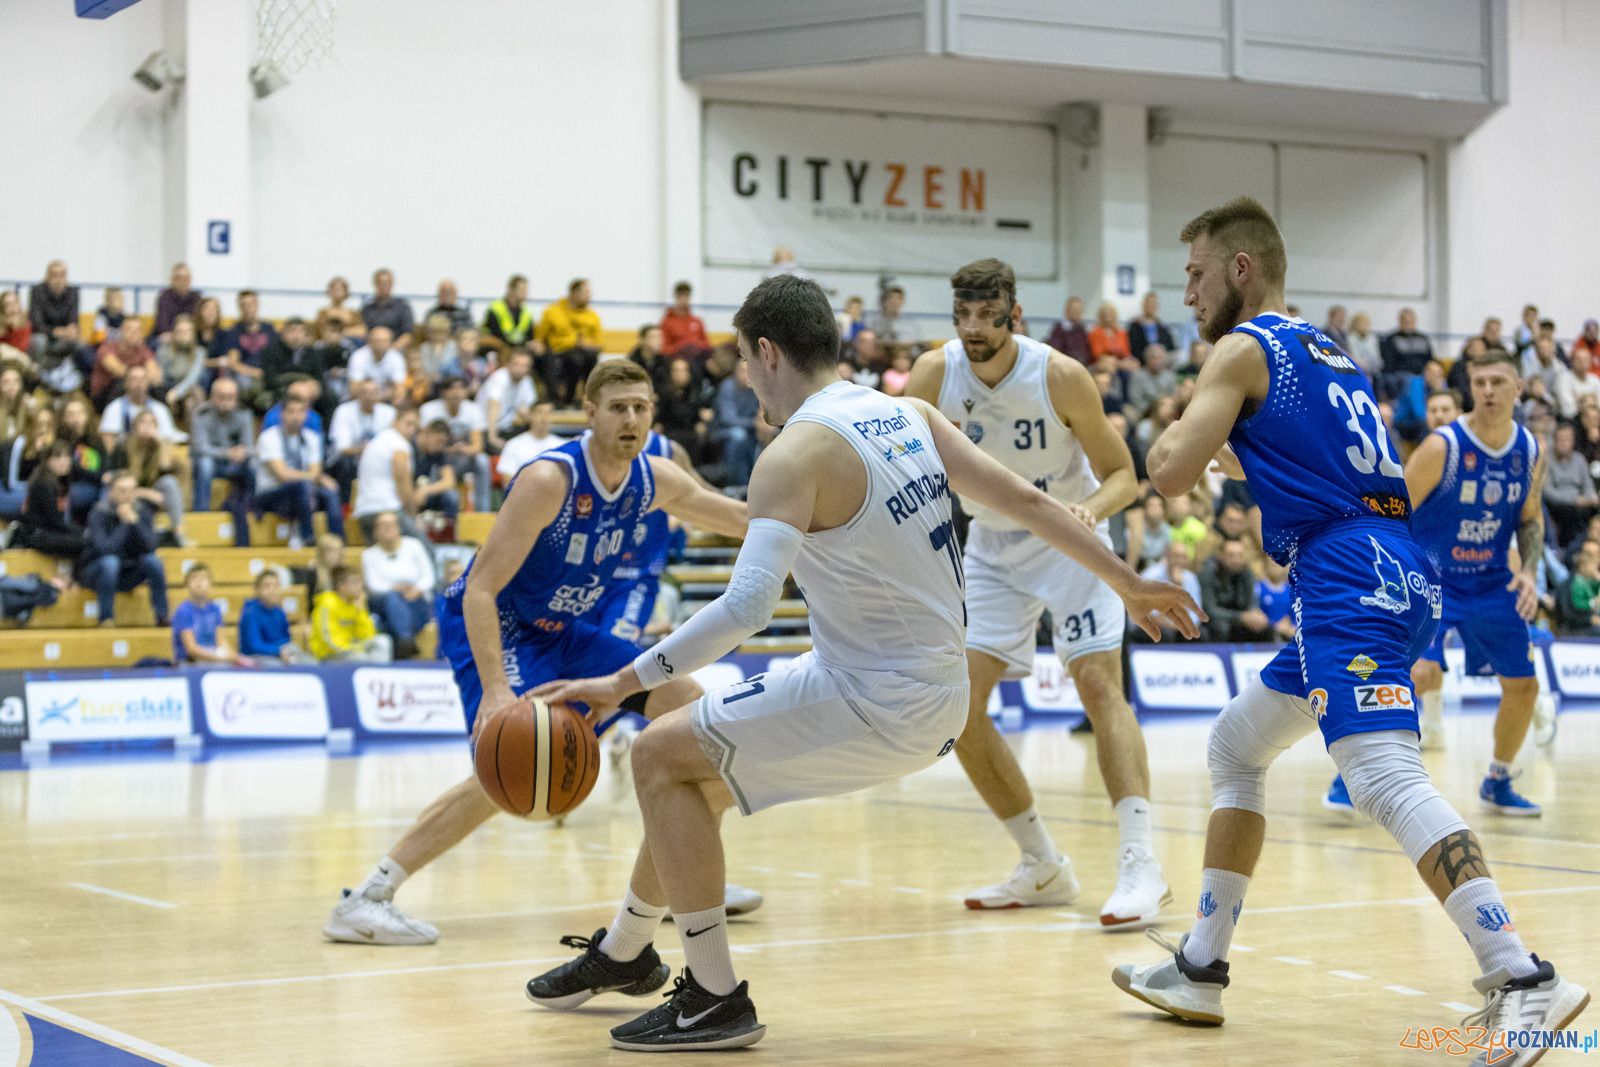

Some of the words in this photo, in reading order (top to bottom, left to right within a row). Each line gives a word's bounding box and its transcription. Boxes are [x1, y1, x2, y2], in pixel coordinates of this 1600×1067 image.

[733, 153, 986, 211] CITYZEN
[1014, 418, 1046, 450] 31
[1328, 382, 1404, 479] 32
[1064, 608, 1097, 642] 31
